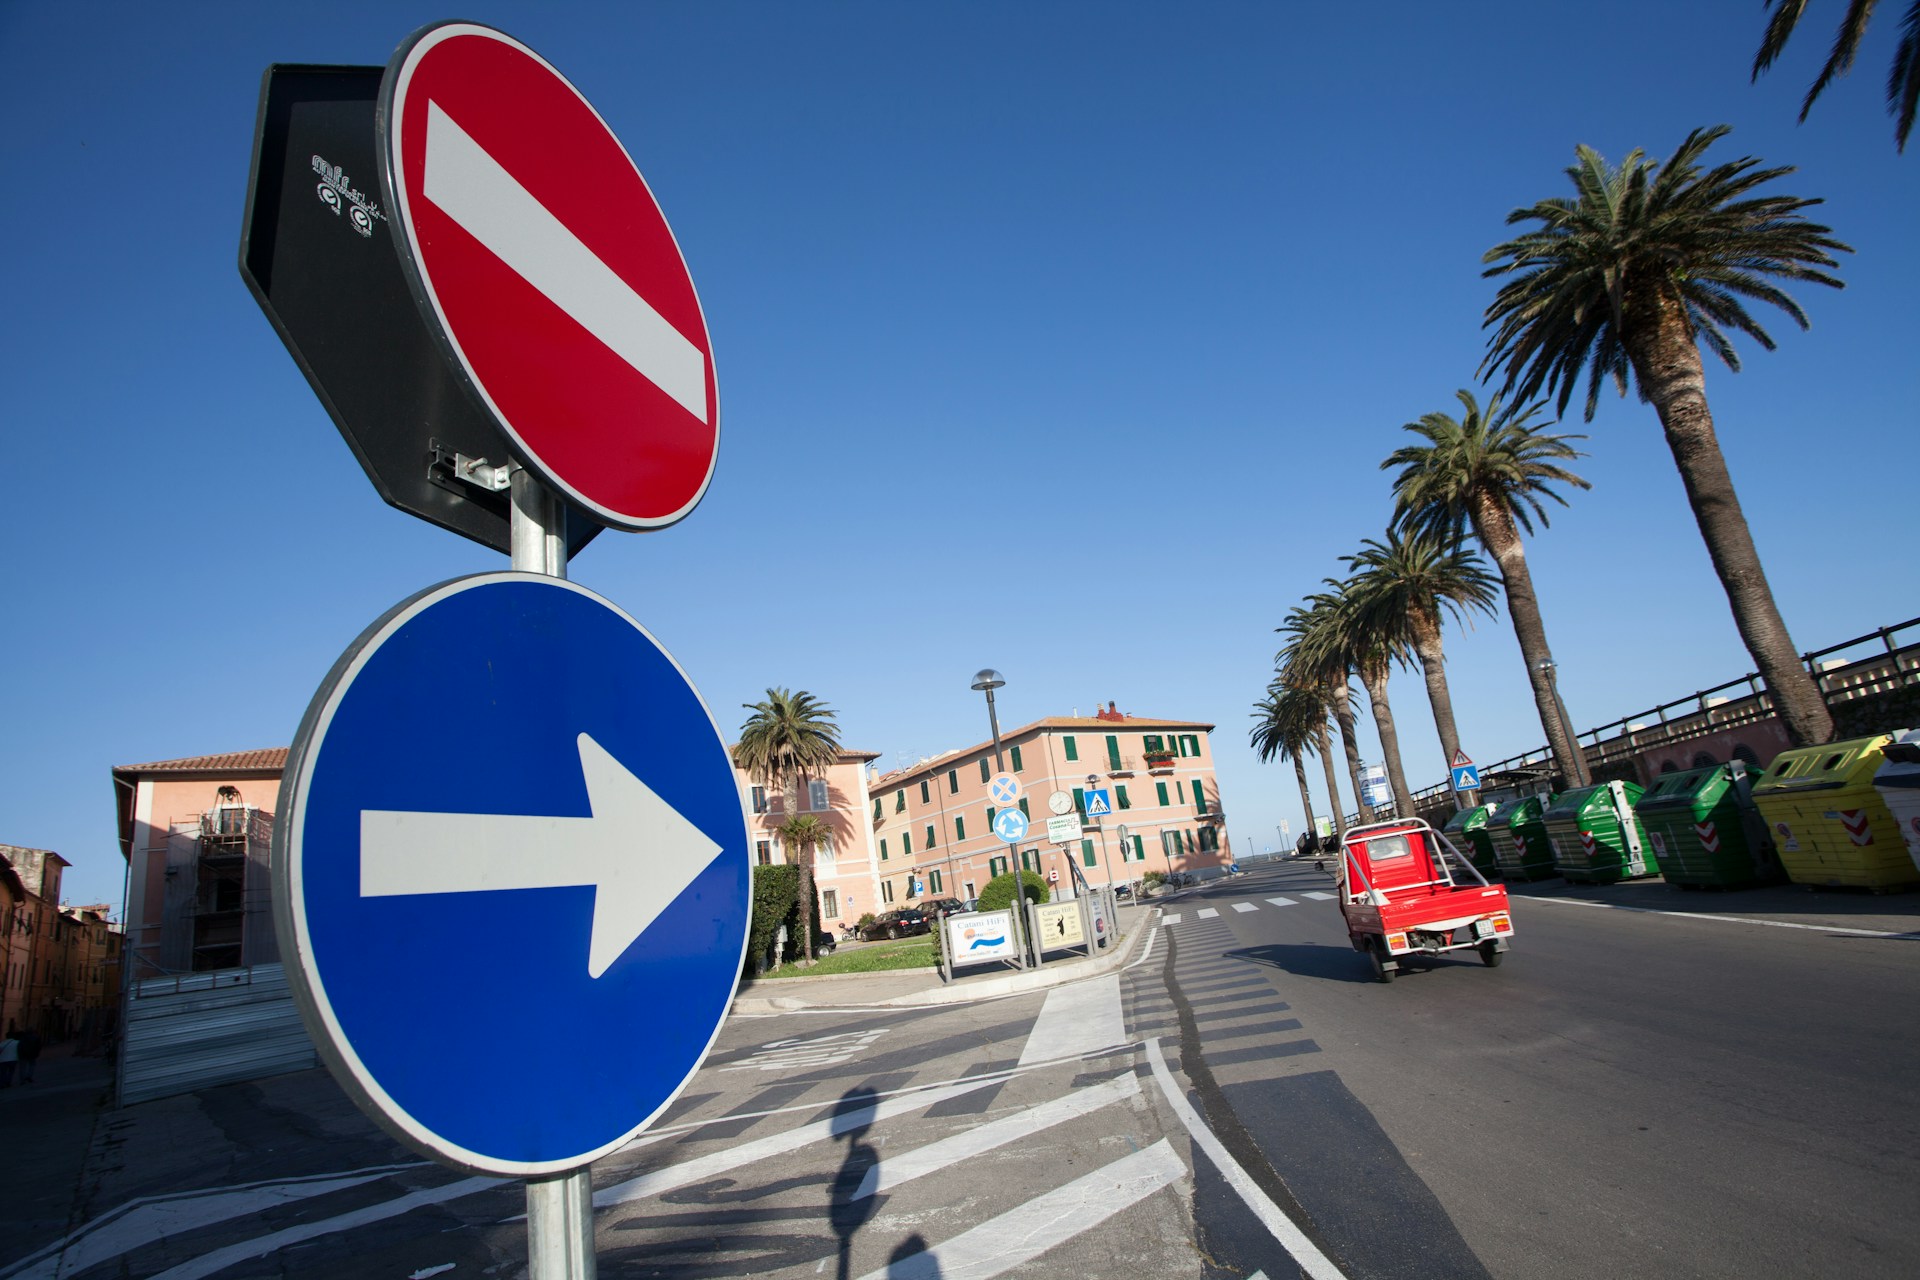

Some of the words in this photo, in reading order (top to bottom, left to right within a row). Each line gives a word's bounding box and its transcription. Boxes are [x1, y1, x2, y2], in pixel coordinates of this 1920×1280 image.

[915, 882, 922, 892] P
[957, 921, 984, 929] Catani
[986, 916, 1005, 926] HiFi
